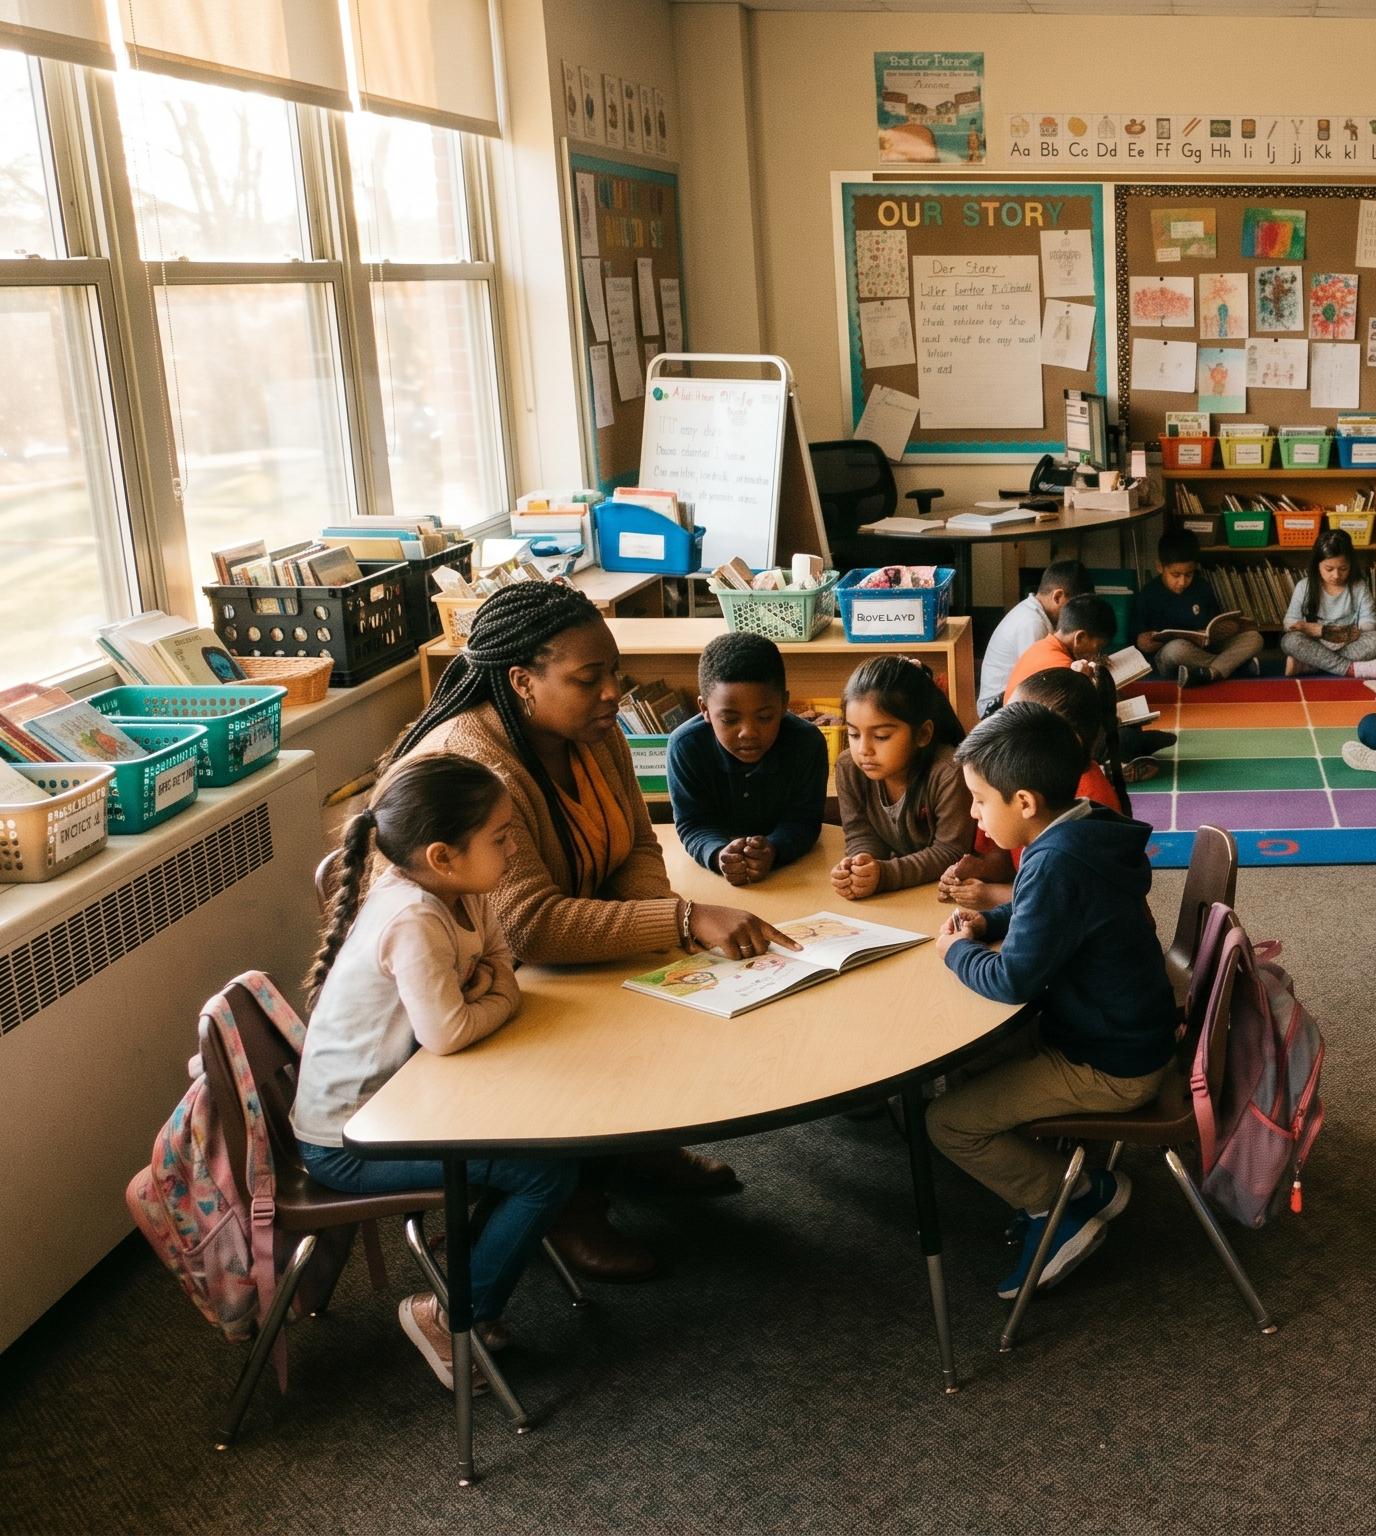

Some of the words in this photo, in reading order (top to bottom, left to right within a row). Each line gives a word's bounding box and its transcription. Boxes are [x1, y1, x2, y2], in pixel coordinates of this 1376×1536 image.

[1010, 142, 1030, 158] Aa
[1040, 142, 1059, 158] Bb
[1068, 142, 1089, 158] Cc
[1097, 142, 1117, 158] Dd
[1128, 142, 1144, 158] Ee
[1156, 142, 1171, 158] Ff
[1181, 143, 1201, 163] Gg
[1211, 143, 1231, 159] Hh
[1315, 144, 1332, 160] Kk
[878, 201, 942, 227] OUR
[963, 201, 1065, 227] STORY
[1258, 838, 1299, 857] G
